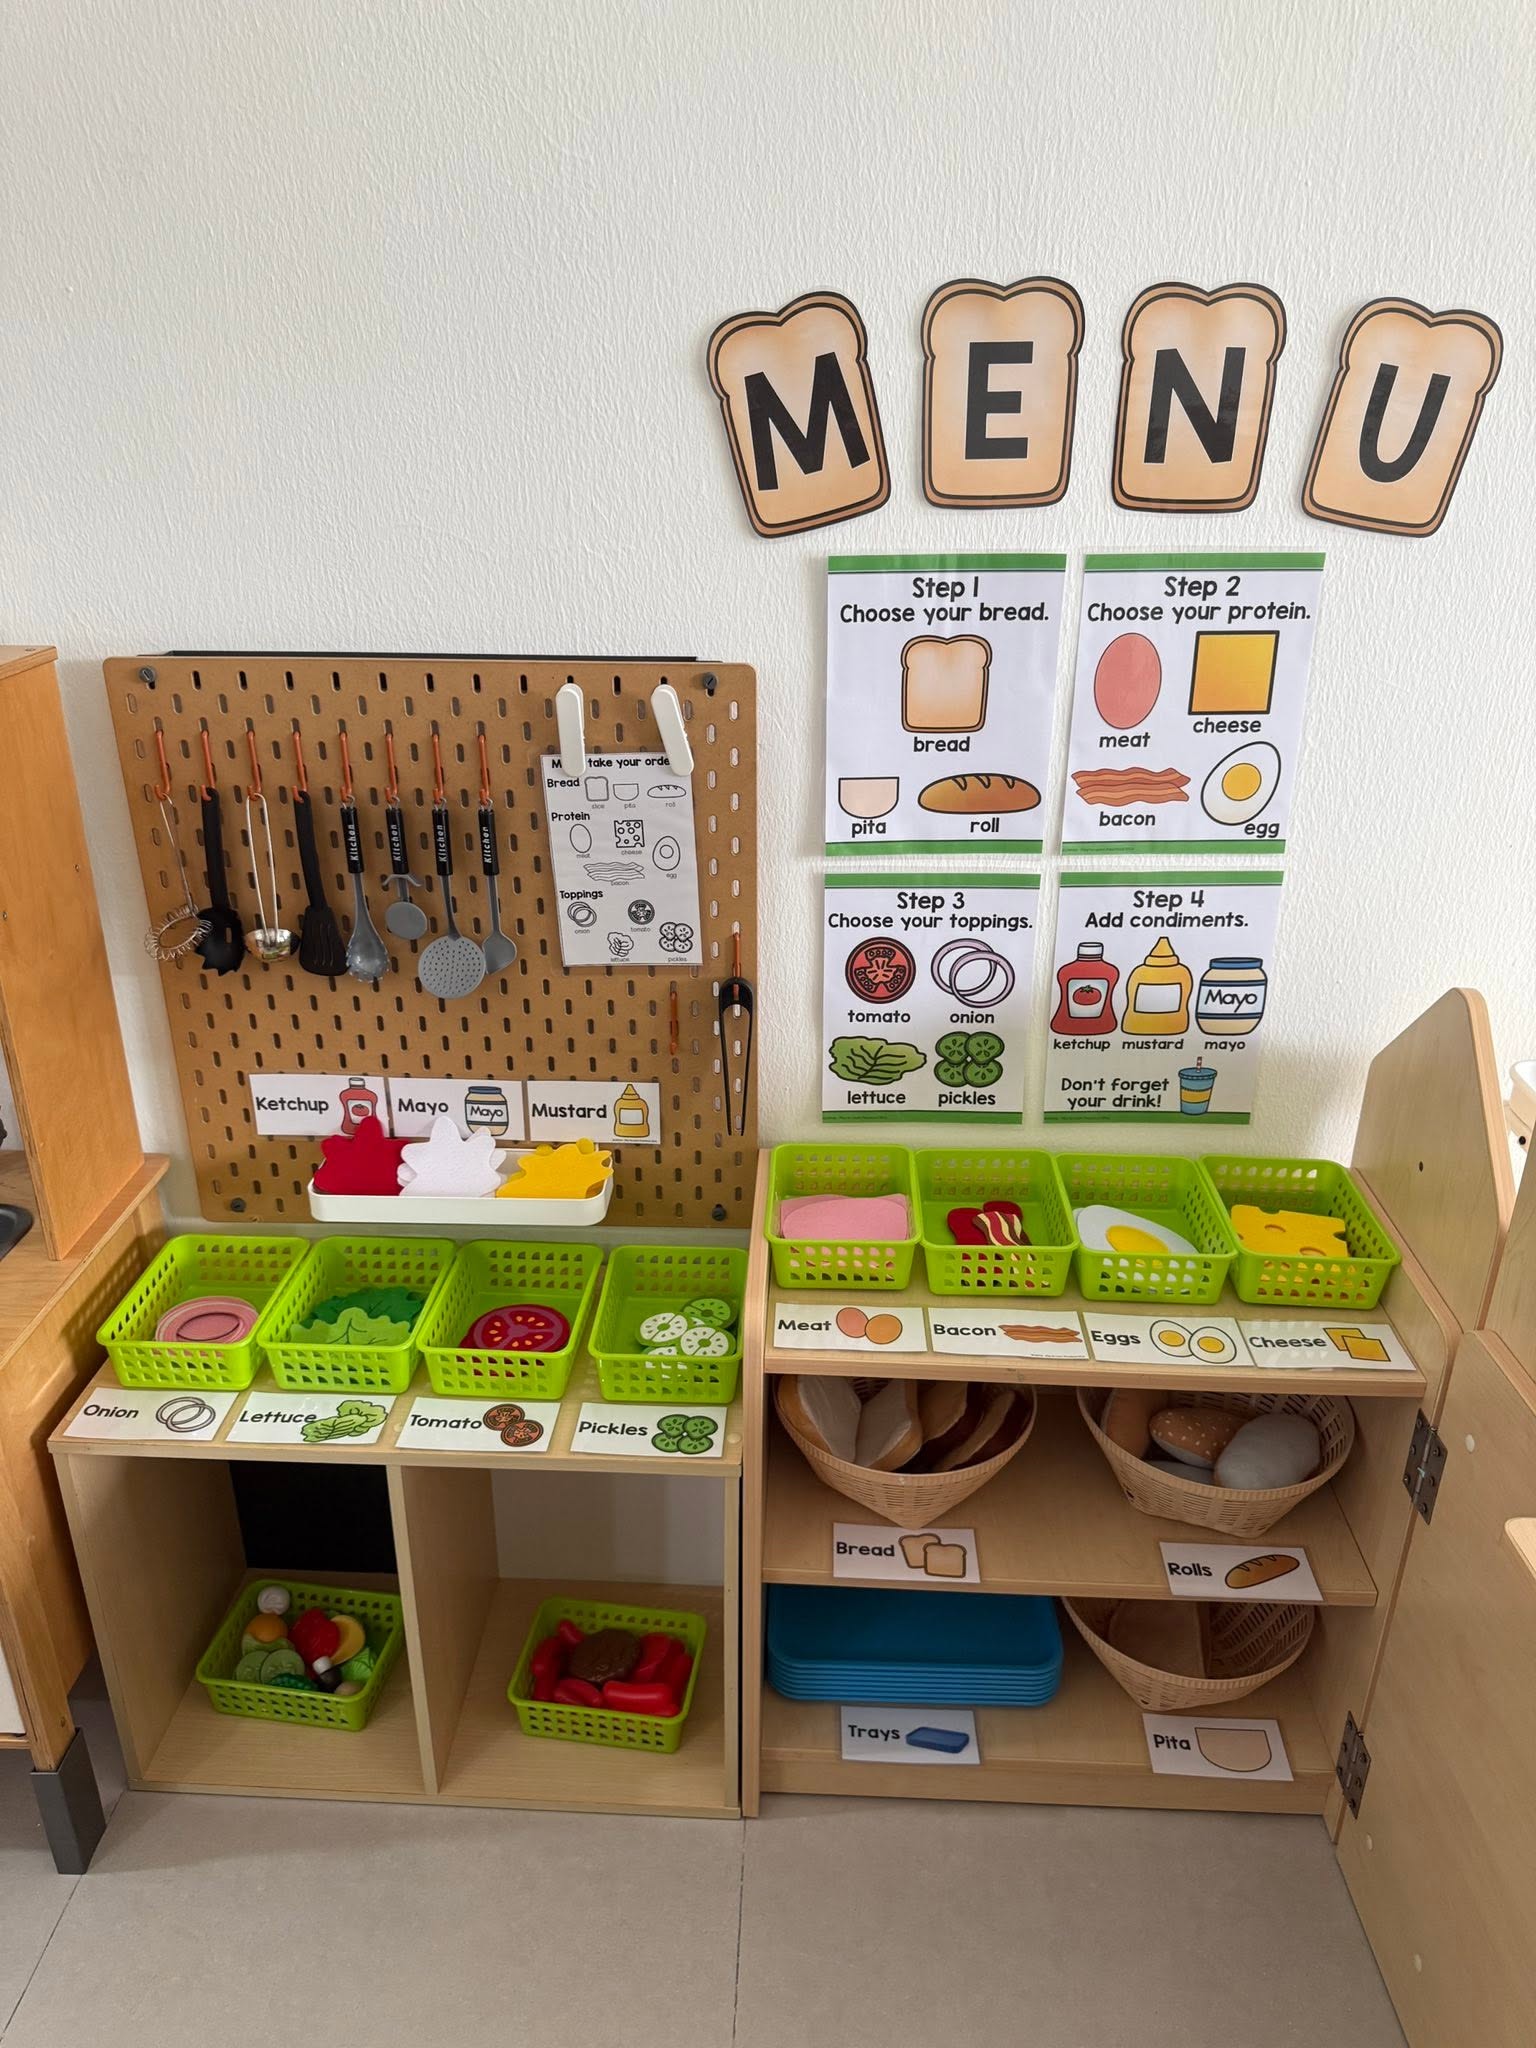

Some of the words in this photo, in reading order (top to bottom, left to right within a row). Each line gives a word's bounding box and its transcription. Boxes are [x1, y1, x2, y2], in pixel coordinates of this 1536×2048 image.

[744, 340, 1451, 491] MENU
[913, 577, 965, 600] Step
[974, 576, 978, 597] 1
[1164, 576, 1217, 600] Step
[1226, 576, 1240, 596] 2
[840, 604, 915, 623] Choose
[923, 607, 972, 625] your
[980, 602, 1048, 621] bread.
[1088, 603, 1163, 621] Choose
[1172, 606, 1221, 624] your
[1228, 602, 1310, 624] protein.
[1193, 717, 1261, 733] cheese
[914, 736, 970, 752] bread
[1099, 732, 1150, 747] meat
[588, 758, 612, 767] take
[616, 759, 641, 768] your
[644, 756, 671, 767] orde
[547, 778, 580, 788] Bread
[551, 812, 590, 821] Protein
[1099, 811, 1155, 826] bacon
[852, 818, 886, 838] pita
[970, 817, 999, 832] roll
[1243, 820, 1279, 838] egg
[560, 890, 603, 900] Toppings
[897, 892, 945, 913] Step
[953, 892, 964, 909] 3
[1133, 890, 1182, 913] Step
[1191, 890, 1204, 907] 4
[829, 913, 893, 928] Choose
[901, 917, 943, 931] your
[950, 914, 1032, 931] toppings.
[1085, 912, 1123, 928] Add
[1130, 910, 1248, 927] condiments.
[1204, 988, 1258, 1014] Mayo
[848, 1010, 910, 1023] tomato
[950, 1011, 994, 1023] onion
[1054, 1039, 1110, 1051] ketchup
[1122, 1039, 1184, 1049] mustard
[1204, 1041, 1245, 1052] mayo
[1062, 1078, 1105, 1091] Don't
[1111, 1078, 1169, 1095] forget
[256, 1097, 329, 1114] Ketchup
[399, 1098, 448, 1115] Mayo
[848, 1091, 906, 1104] lettuce
[939, 1091, 995, 1107] pickles
[1066, 1097, 1108, 1112] your
[1113, 1093, 1161, 1107] drink!
[470, 1106, 504, 1121] Mayo
[532, 1104, 607, 1118] Mustard
[778, 1320, 831, 1330] Meat
[934, 1324, 996, 1336] Bacon
[1090, 1331, 1141, 1347] Eggs
[1249, 1336, 1323, 1349] Cheese
[82, 1403, 139, 1418] Onion
[239, 1410, 316, 1424] Lettuce
[411, 1415, 482, 1429] Tomato
[577, 1419, 648, 1436] Pickles
[837, 1542, 894, 1556] Bread
[1168, 1563, 1212, 1576] Rolls
[848, 1725, 900, 1741] Trays
[1153, 1734, 1191, 1750] Pita
